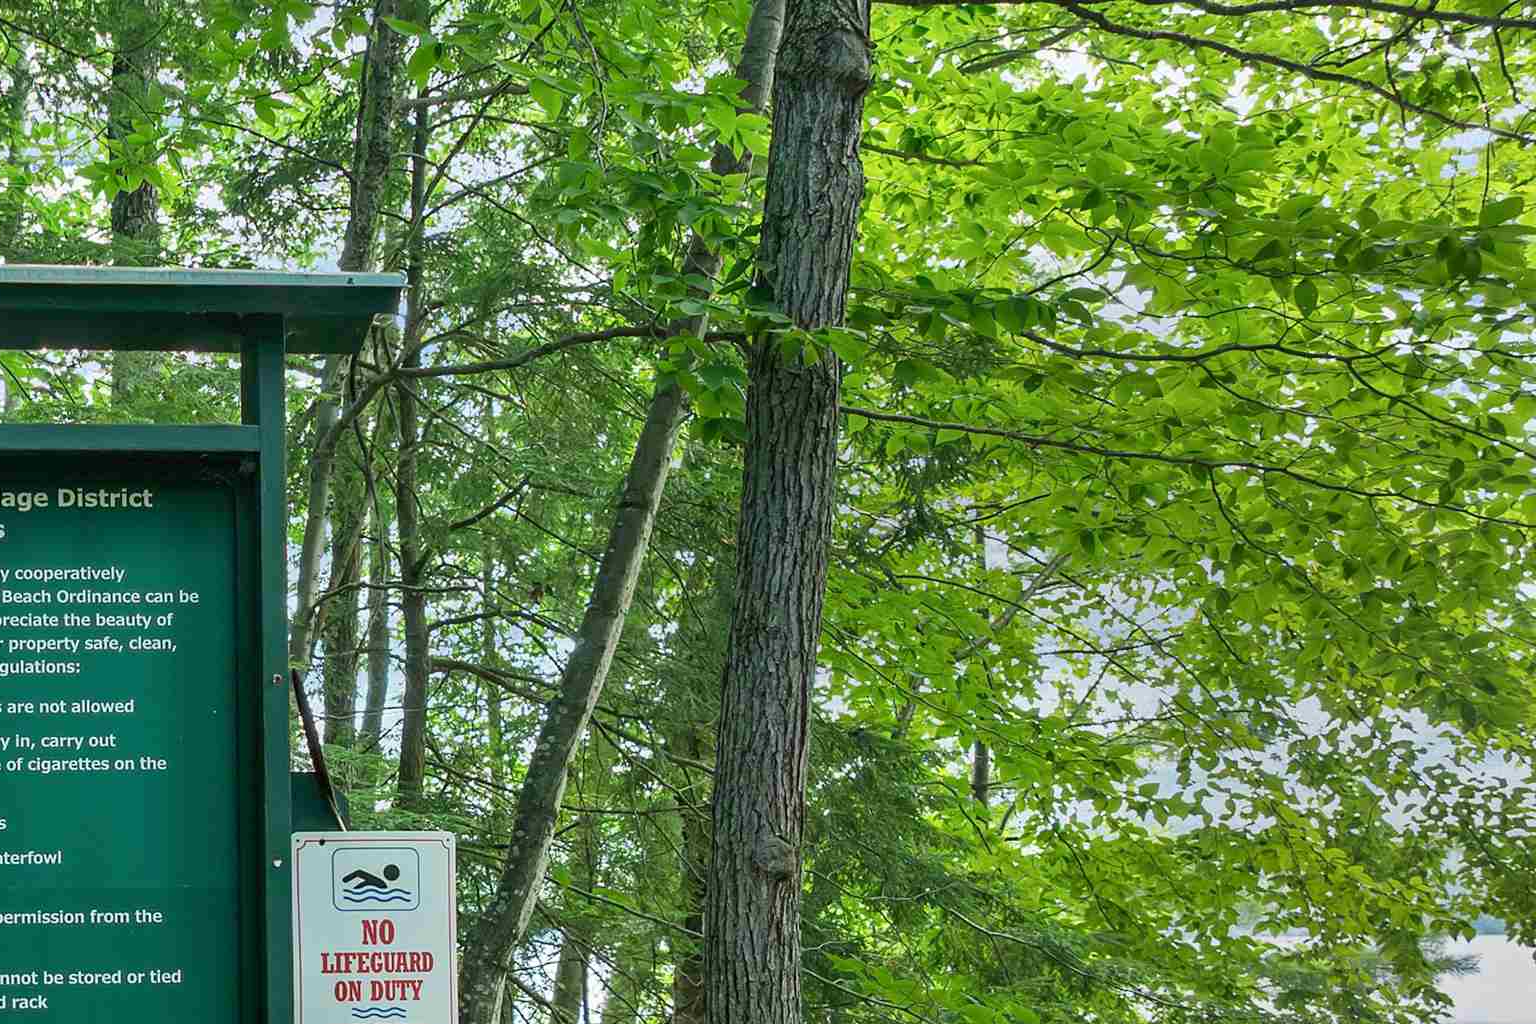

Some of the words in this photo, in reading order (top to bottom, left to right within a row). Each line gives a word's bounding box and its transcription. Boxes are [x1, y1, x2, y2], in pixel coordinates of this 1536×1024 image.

[57, 486, 153, 508] District
[14, 564, 125, 583] cooperatively
[63, 612, 91, 627] the
[95, 612, 152, 629] beauty
[155, 611, 174, 626] of
[6, 701, 34, 713] are
[38, 699, 67, 714] not
[70, 698, 134, 713] allowed
[15, 733, 35, 750] in,
[40, 735, 84, 750] carry
[87, 733, 116, 748] out
[361, 919, 396, 945] NO
[320, 951, 434, 974] LIFEGUARD
[334, 981, 363, 1002] ON
[370, 979, 423, 1001] DUTY
[11, 994, 48, 1009] rack
